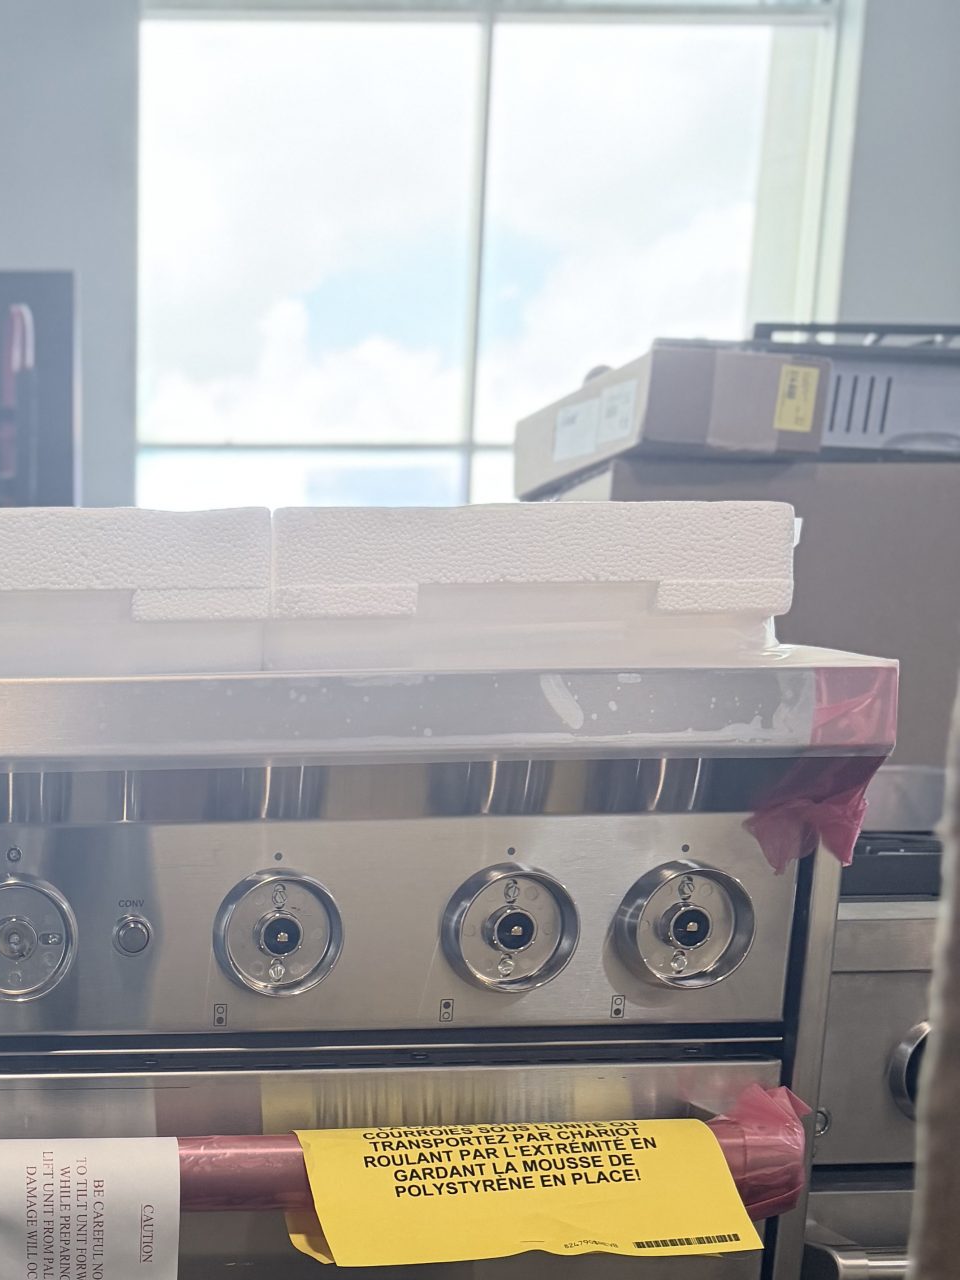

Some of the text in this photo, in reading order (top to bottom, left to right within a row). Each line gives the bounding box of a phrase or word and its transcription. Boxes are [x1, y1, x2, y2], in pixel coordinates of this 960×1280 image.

[117, 900, 145, 908] CONV
[363, 1137, 656, 1168] ROULANT PAR L'EXTRÉMITÉ EN
[369, 1127, 641, 1152] TRANSPORTEZ PAR CHARIOT
[42, 1150, 54, 1179] LIFT
[76, 1156, 87, 1176] TO
[393, 1153, 637, 1182] GARDANT LA MOUSSE DE
[26, 1165, 37, 1228] DAMAGE
[42, 1182, 54, 1216] UNIT
[59, 1166, 70, 1212] WHILE
[76, 1178, 87, 1211] TILT
[93, 1179, 104, 1198] BE
[393, 1169, 642, 1198] POLYSTYRÈNE EN PLACE!
[26, 1229, 38, 1259] WILL
[43, 1219, 54, 1254] FROM
[76, 1213, 87, 1245] UNIT
[92, 1201, 104, 1260] CAREFUL
[141, 1203, 154, 1264] CAUTION
